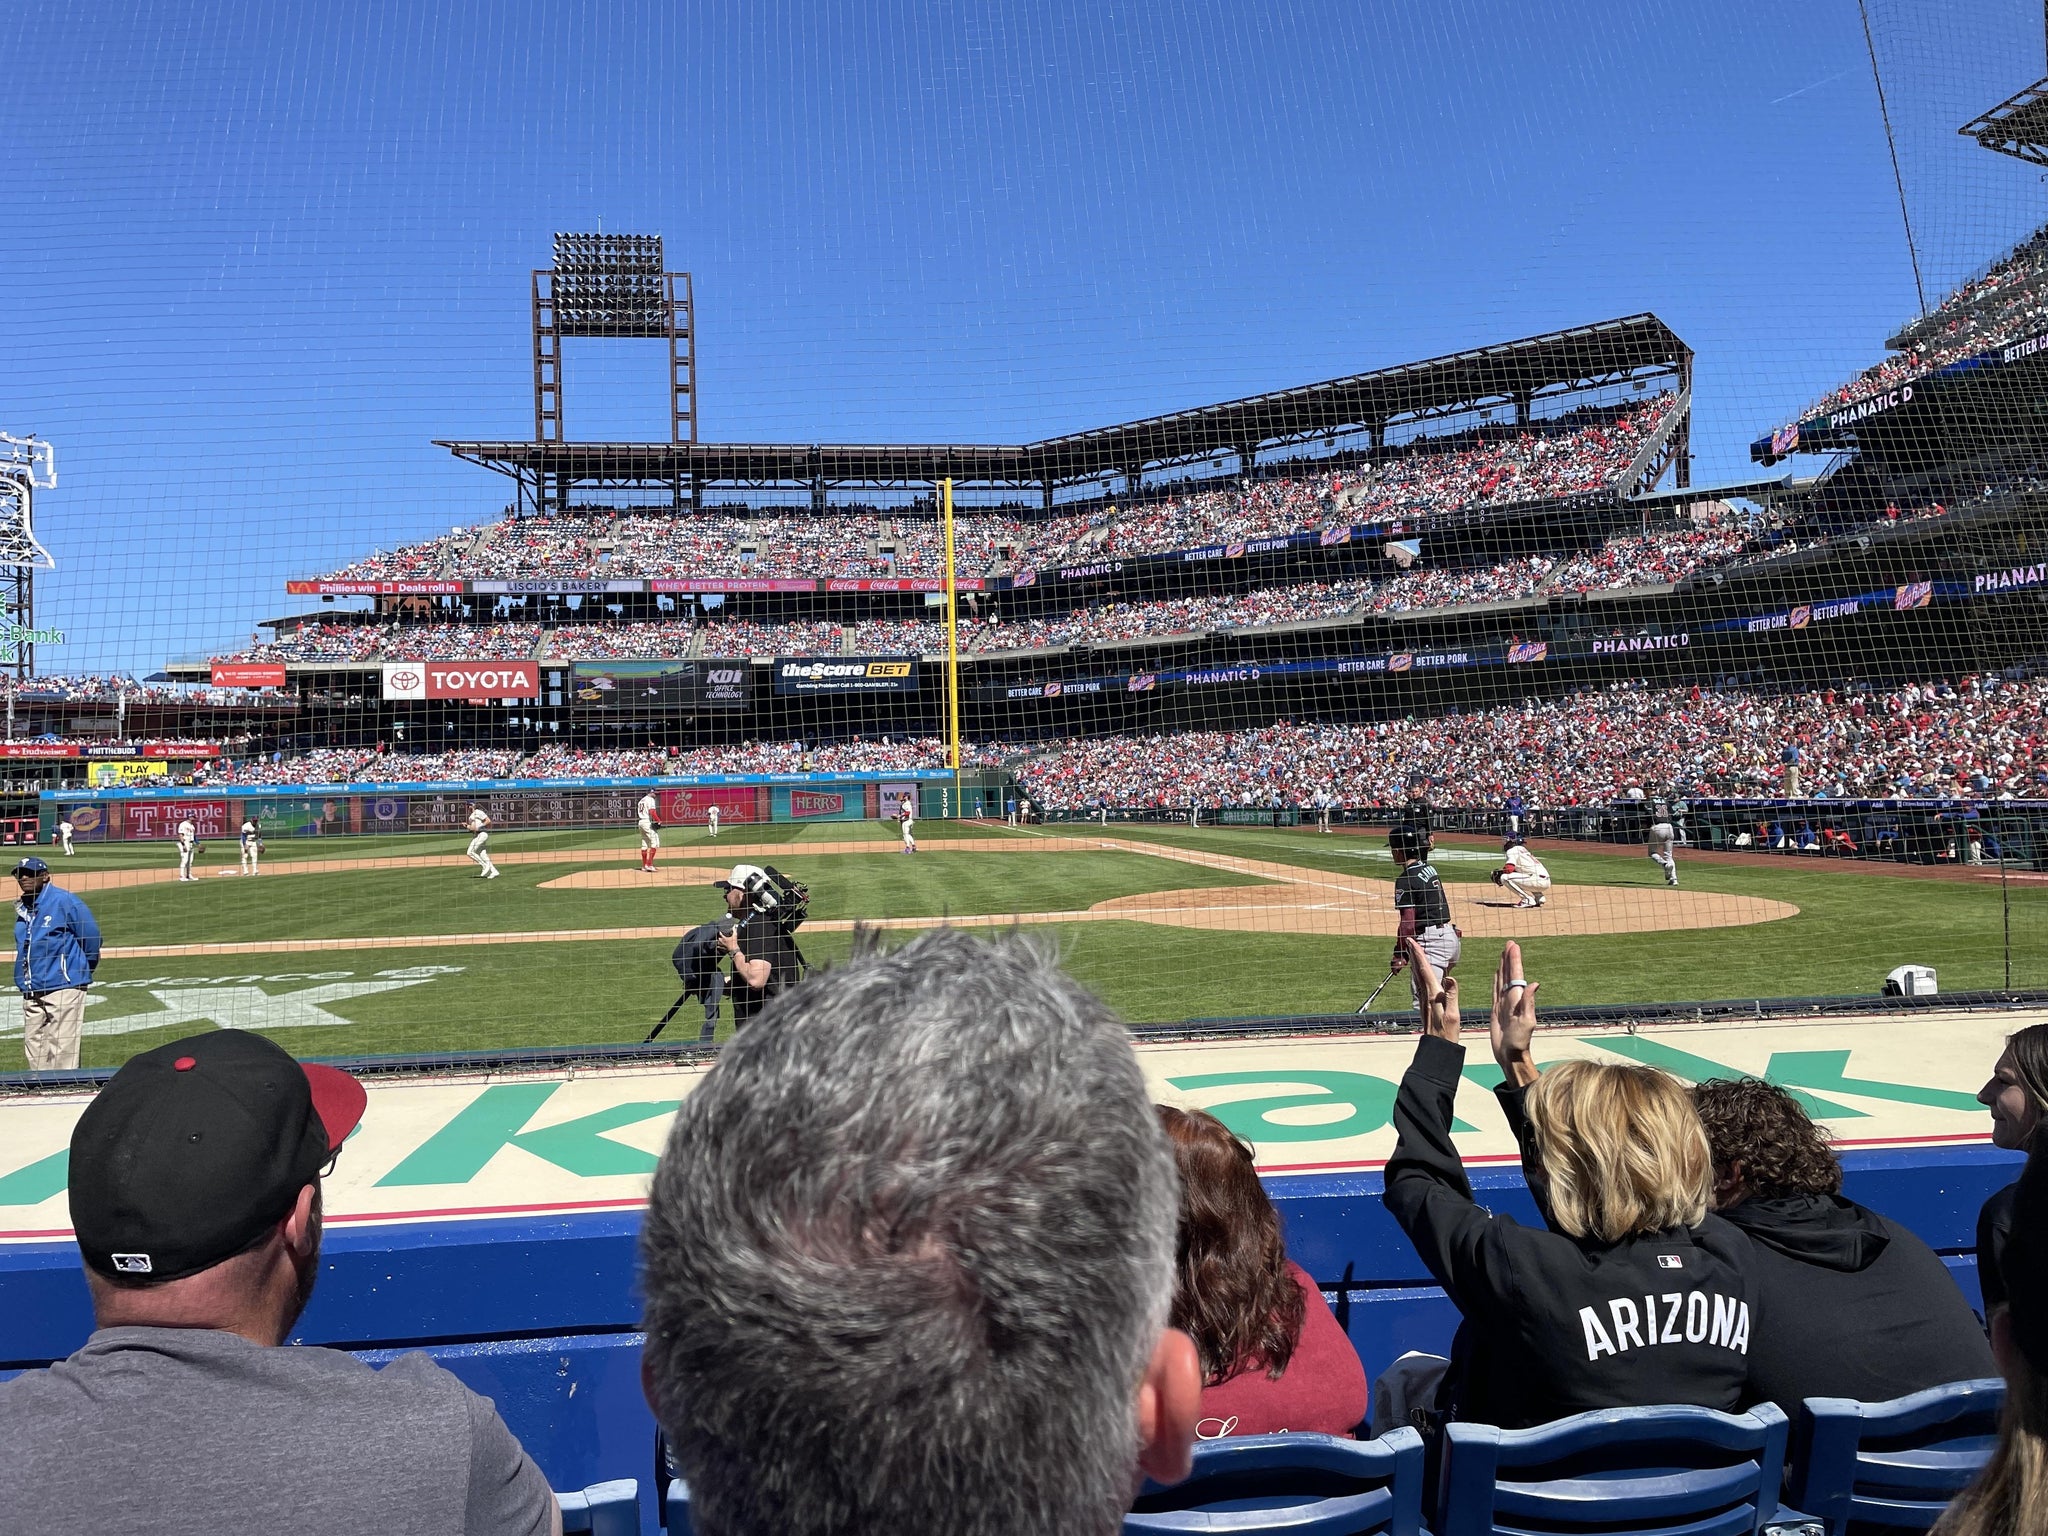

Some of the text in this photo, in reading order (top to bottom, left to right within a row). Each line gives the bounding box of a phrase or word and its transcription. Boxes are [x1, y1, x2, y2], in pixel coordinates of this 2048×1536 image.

[2004, 339, 2038, 363] BETTER
[1831, 391, 1898, 428] PHANATIC
[1902, 386, 1913, 402] D
[1060, 564, 1111, 579] PHANATIC
[1115, 562, 1122, 572] D
[1185, 549, 1206, 561] BETTER
[1207, 547, 1223, 559] CARE
[1247, 541, 1270, 553] BETTER
[1272, 539, 1288, 551] PORK
[320, 583, 376, 593] Phillies win
[400, 583, 456, 592] Deals roll in
[508, 580, 609, 590] LISCIO'S BAKERY
[656, 581, 687, 591] WHEY
[690, 581, 725, 590] BETTER
[728, 580, 770, 590] PROTEIN
[829, 580, 860, 591] Coca-Cola
[870, 580, 900, 590] Coca-Cola
[910, 580, 941, 590] Coca-Cola
[10, 626, 63, 645] Bank
[1186, 670, 1248, 685] PHANATIC
[1252, 669, 1260, 680] D
[1337, 660, 1365, 673] BETTER
[1366, 659, 1385, 670] CARE
[1416, 655, 1445, 667] BETTER
[1447, 653, 1468, 664] PORK
[1507, 642, 1547, 663] Hatfield
[1592, 635, 1678, 653] PHANATIC
[1681, 633, 1689, 646] D
[1748, 618, 1770, 633] BETTER
[1771, 614, 1788, 629] CARE
[1813, 605, 1839, 621] BETTER
[1840, 601, 1859, 616] PORK
[782, 662, 909, 678] theScore BET
[431, 670, 531, 689] TOYOTA
[706, 669, 744, 683] KDI
[714, 684, 734, 692] OFFICE
[795, 682, 818, 690] Gambling
[1008, 687, 1028, 698] BETTER
[1029, 687, 1042, 697] CARE
[1063, 684, 1085, 694] BETTER
[1085, 682, 1100, 692] PORK
[705, 690, 744, 699] TECHNOLOGY
[21, 747, 68, 757] Budweiser
[168, 747, 210, 757] Budweiser
[123, 764, 149, 775] PLAY
[432, 803, 445, 812] ATH
[491, 802, 504, 811] CLE
[549, 800, 564, 810] COL
[607, 799, 622, 808] BOS
[672, 798, 744, 820] Chickil-A
[796, 796, 838, 812] HERR'S
[163, 805, 223, 822] Temple
[430, 815, 447, 823] NYM
[492, 812, 504, 821] ATL
[608, 810, 621, 819] STL
[1258, 811, 1291, 822] PICES
[164, 821, 219, 836] Hlth
[1578, 1290, 1750, 1362] ARIZONA
